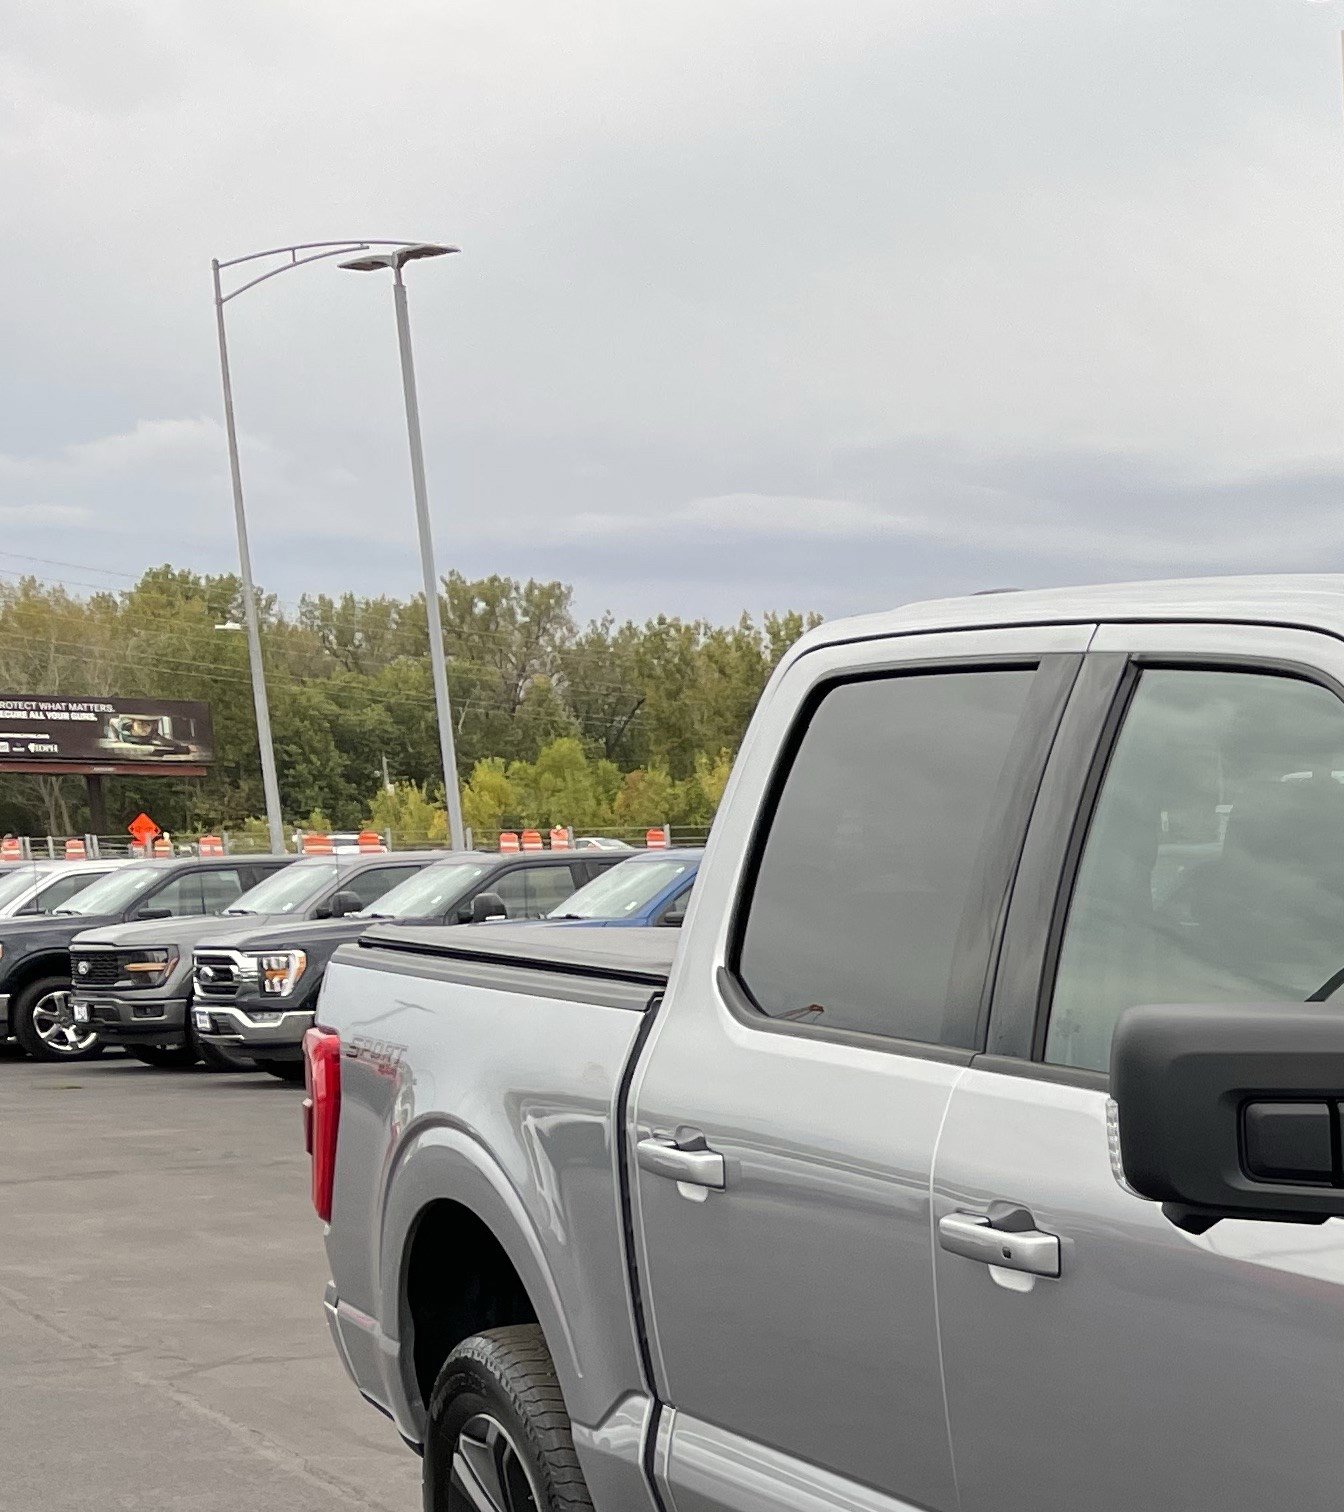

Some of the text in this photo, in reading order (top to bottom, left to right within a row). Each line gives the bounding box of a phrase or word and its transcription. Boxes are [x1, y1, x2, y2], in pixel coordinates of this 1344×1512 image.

[39, 701, 67, 711] WHAT
[69, 702, 115, 713] MATTERS.
[29, 710, 46, 720] ALL
